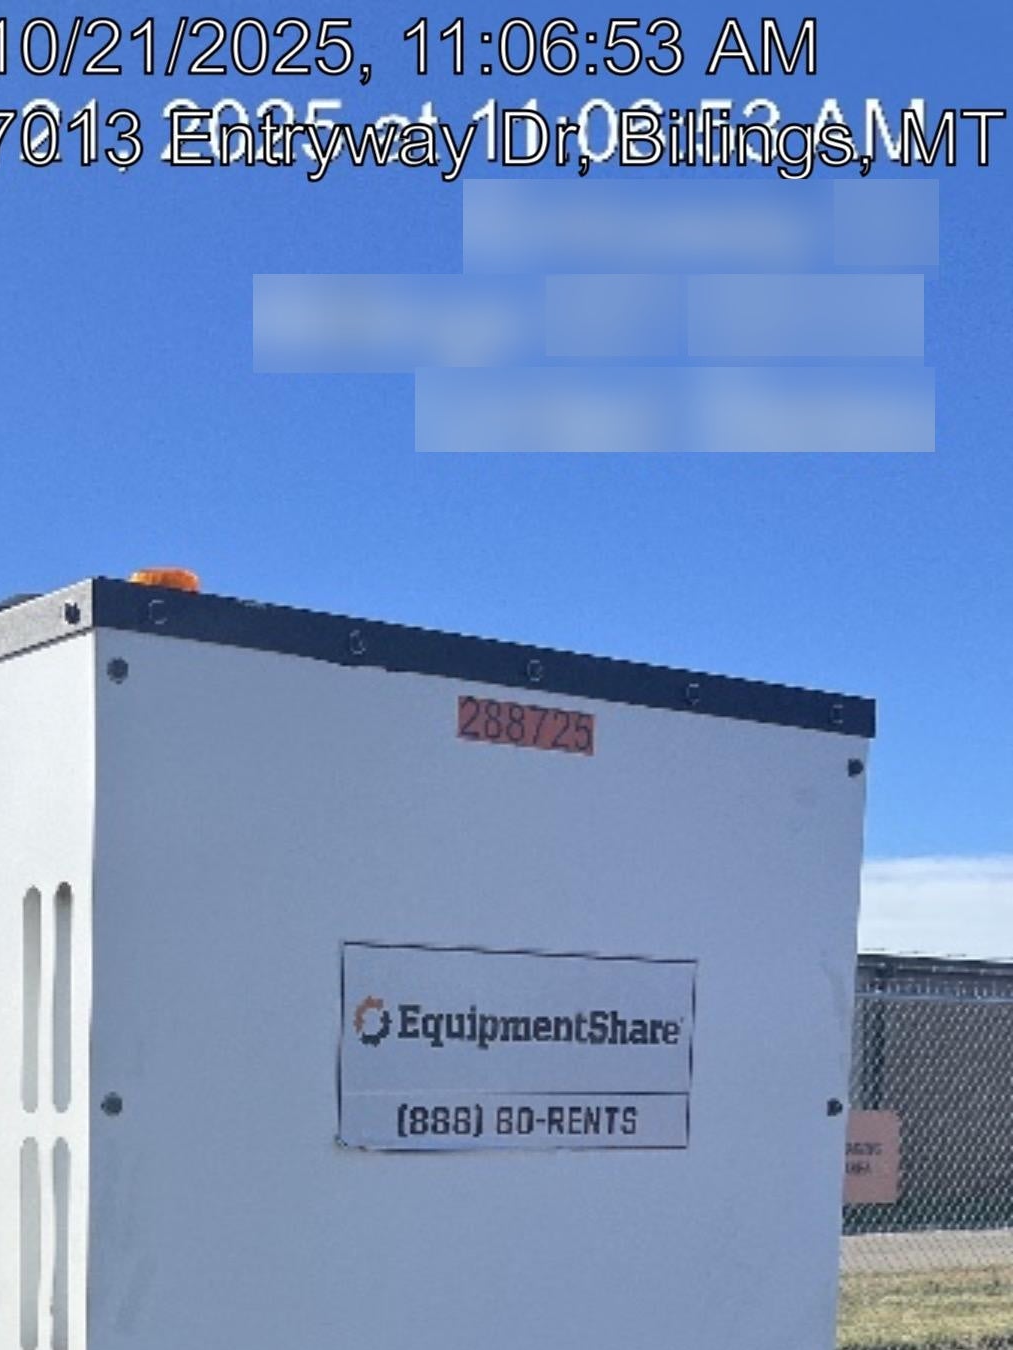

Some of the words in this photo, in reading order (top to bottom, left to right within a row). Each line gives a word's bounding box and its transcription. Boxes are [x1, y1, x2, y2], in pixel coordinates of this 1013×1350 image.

[460, 696, 594, 751] 288725
[397, 1004, 681, 1049] EquipmentShare
[397, 1103, 483, 1137] (888)
